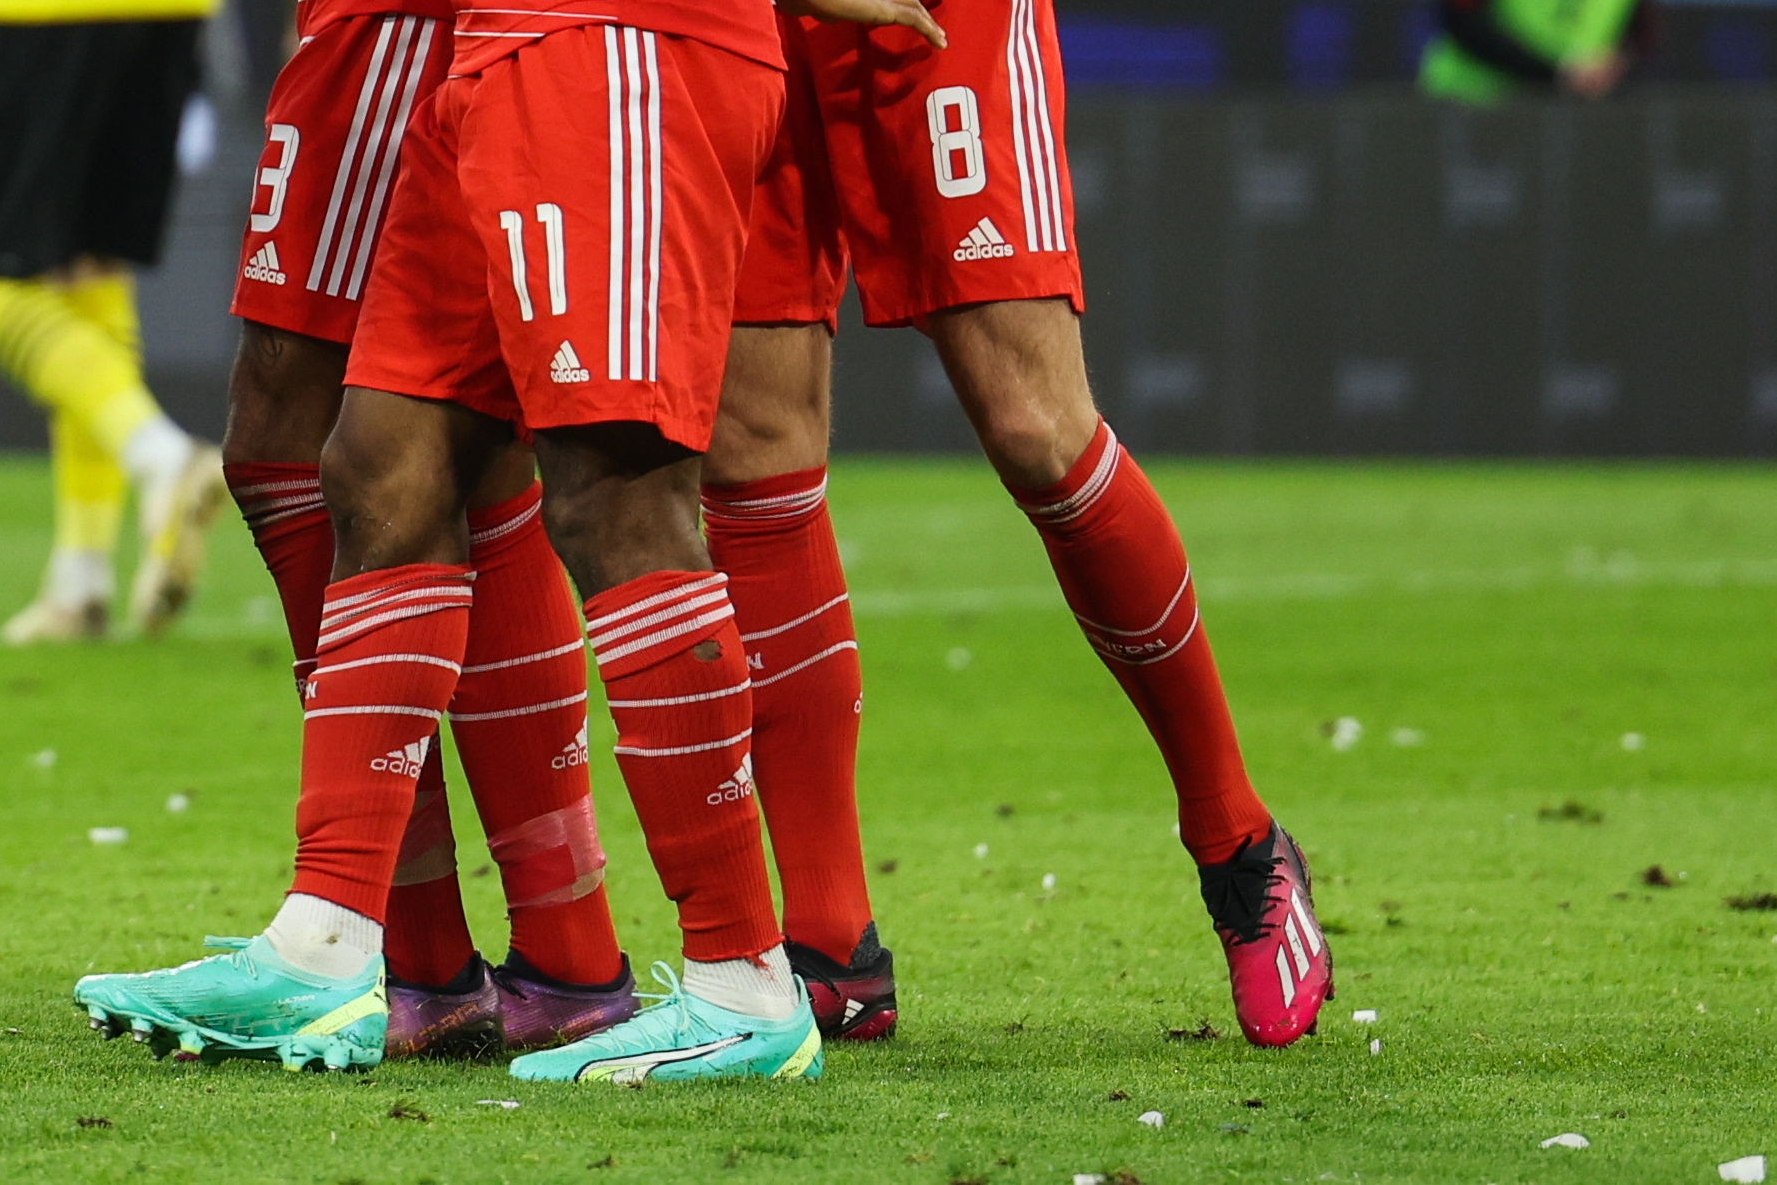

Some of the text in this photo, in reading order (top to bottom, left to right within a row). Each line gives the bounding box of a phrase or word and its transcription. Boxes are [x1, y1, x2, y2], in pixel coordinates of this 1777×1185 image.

[926, 85, 986, 198] 8
[250, 124, 300, 232] 3
[244, 265, 287, 286] adidas
[499, 202, 567, 322] 11
[953, 243, 1015, 262] adidas
[551, 369, 589, 383] adidas
